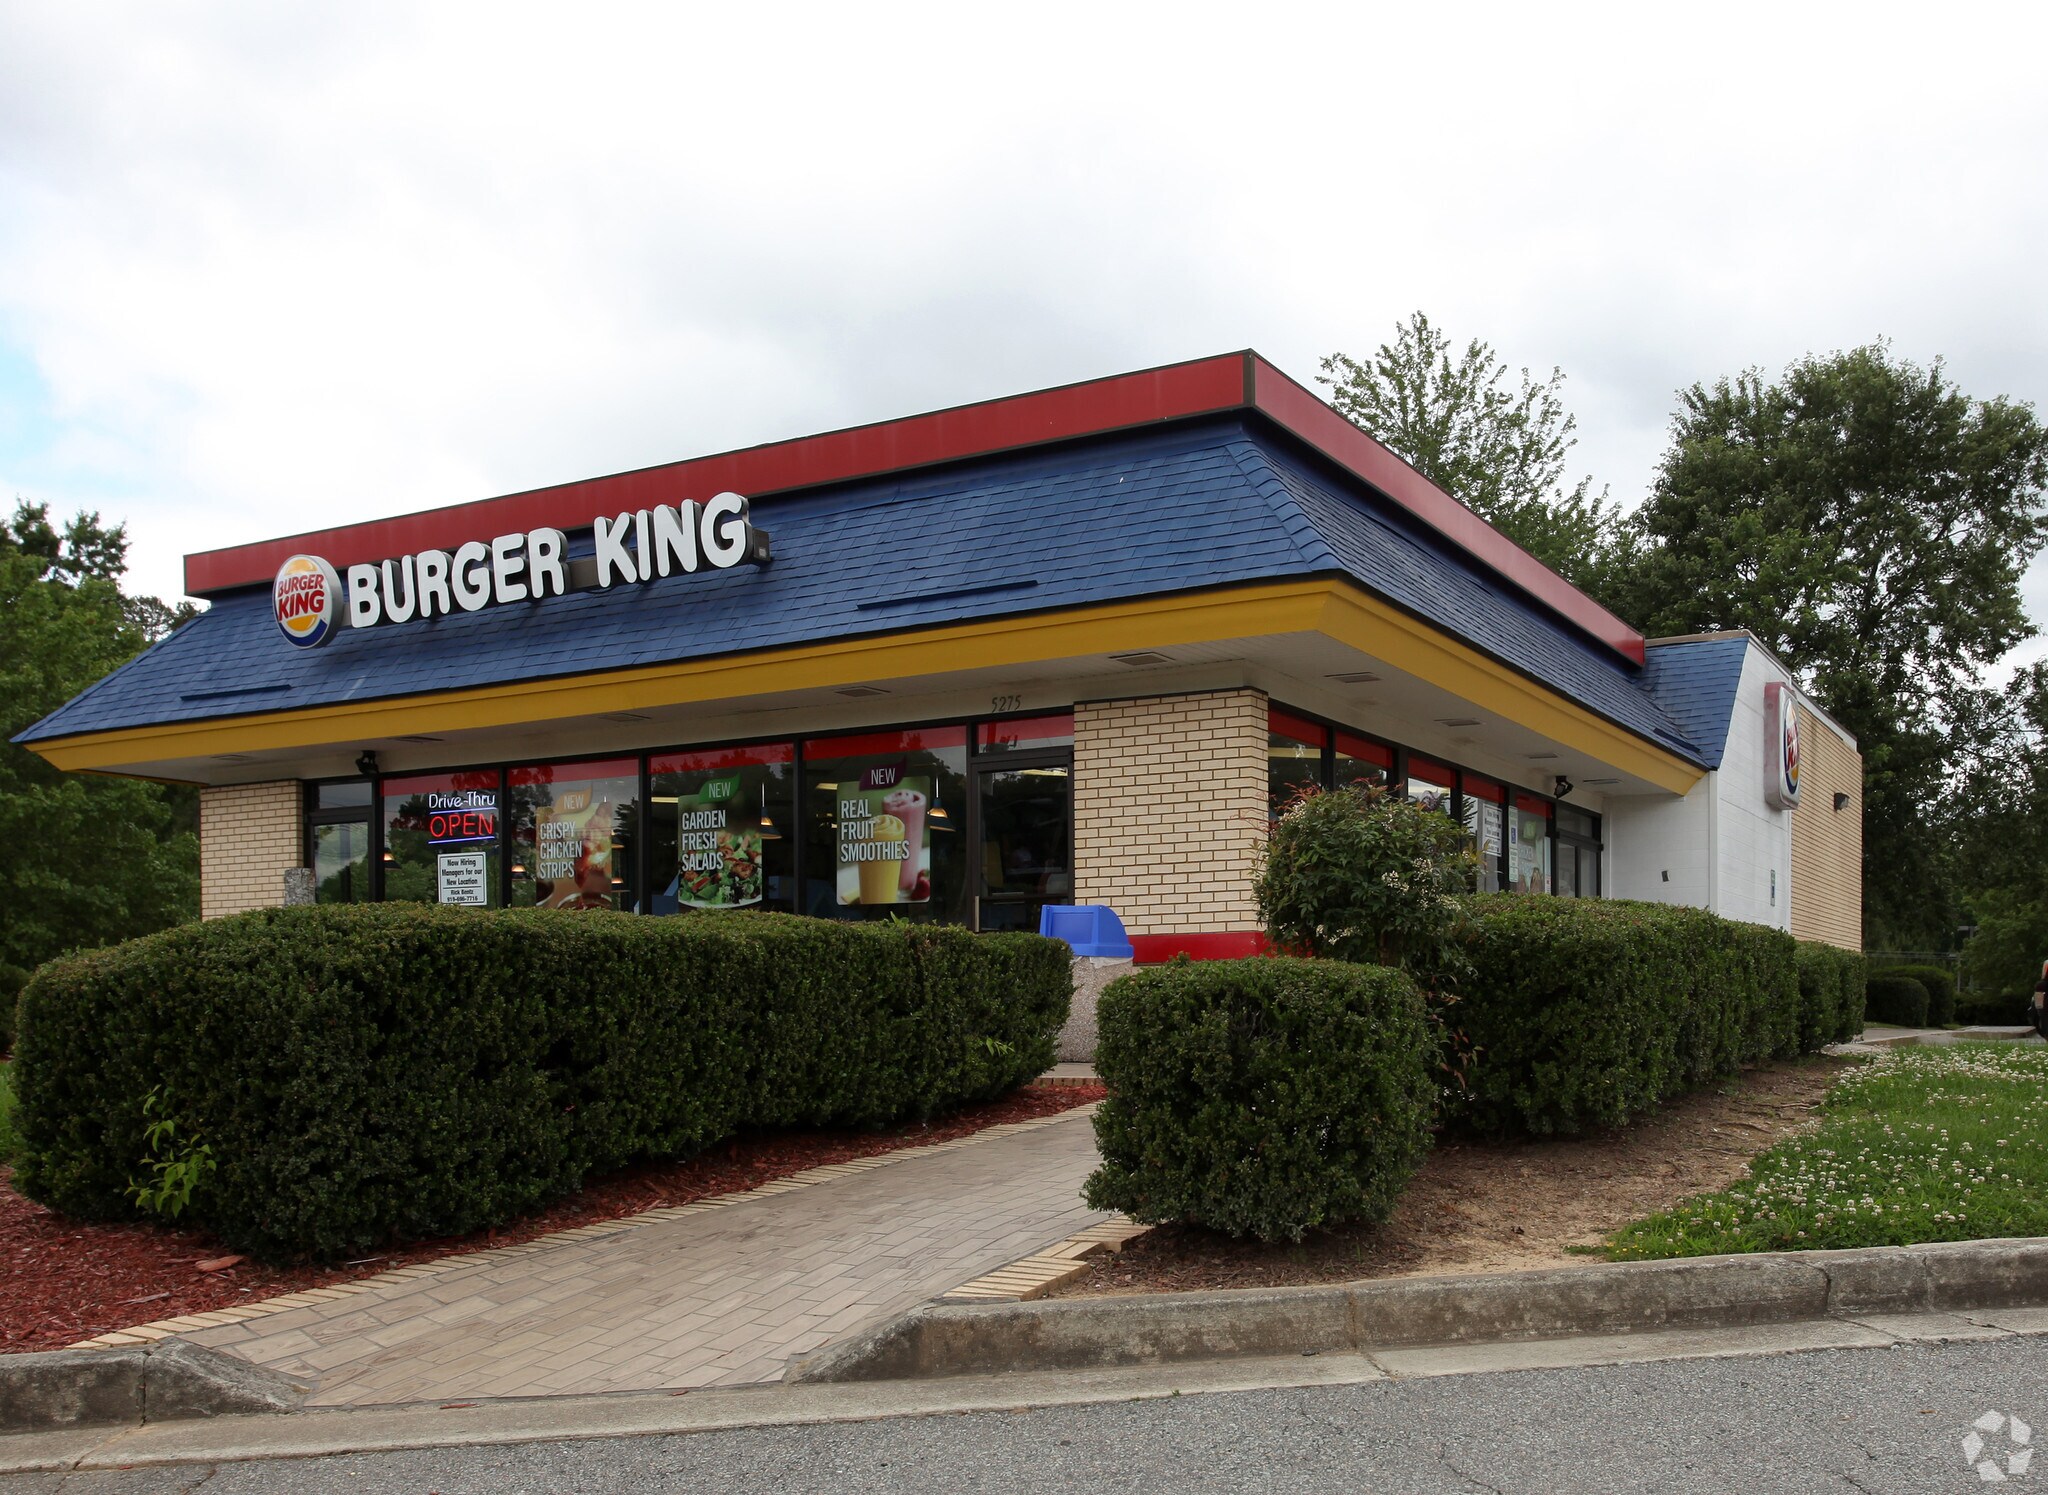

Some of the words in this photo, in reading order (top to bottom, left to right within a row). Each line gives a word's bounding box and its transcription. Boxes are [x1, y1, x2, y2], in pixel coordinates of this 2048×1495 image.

[347, 527, 568, 628] BURGER
[593, 491, 749, 588] KING
[277, 574, 324, 597] BURGER
[278, 590, 325, 621] KING
[991, 695, 1022, 713] 5275
[870, 768, 896, 785] NEW
[428, 791, 495, 808] Drive-Thru
[708, 782, 731, 798] NEW
[563, 795, 584, 810] NEW
[841, 799, 872, 819] REAL
[430, 813, 495, 838] OPEN
[681, 809, 726, 830] GARDEN
[539, 821, 577, 840] CRISPY
[841, 820, 876, 841] FRUIT
[539, 841, 583, 860] CHICKEN
[681, 831, 718, 851] FRESH
[840, 840, 910, 862] SMOOTHIES
[460, 858, 477, 867] Hiring
[539, 861, 575, 879] STRIPS
[681, 852, 724, 872] SALADS
